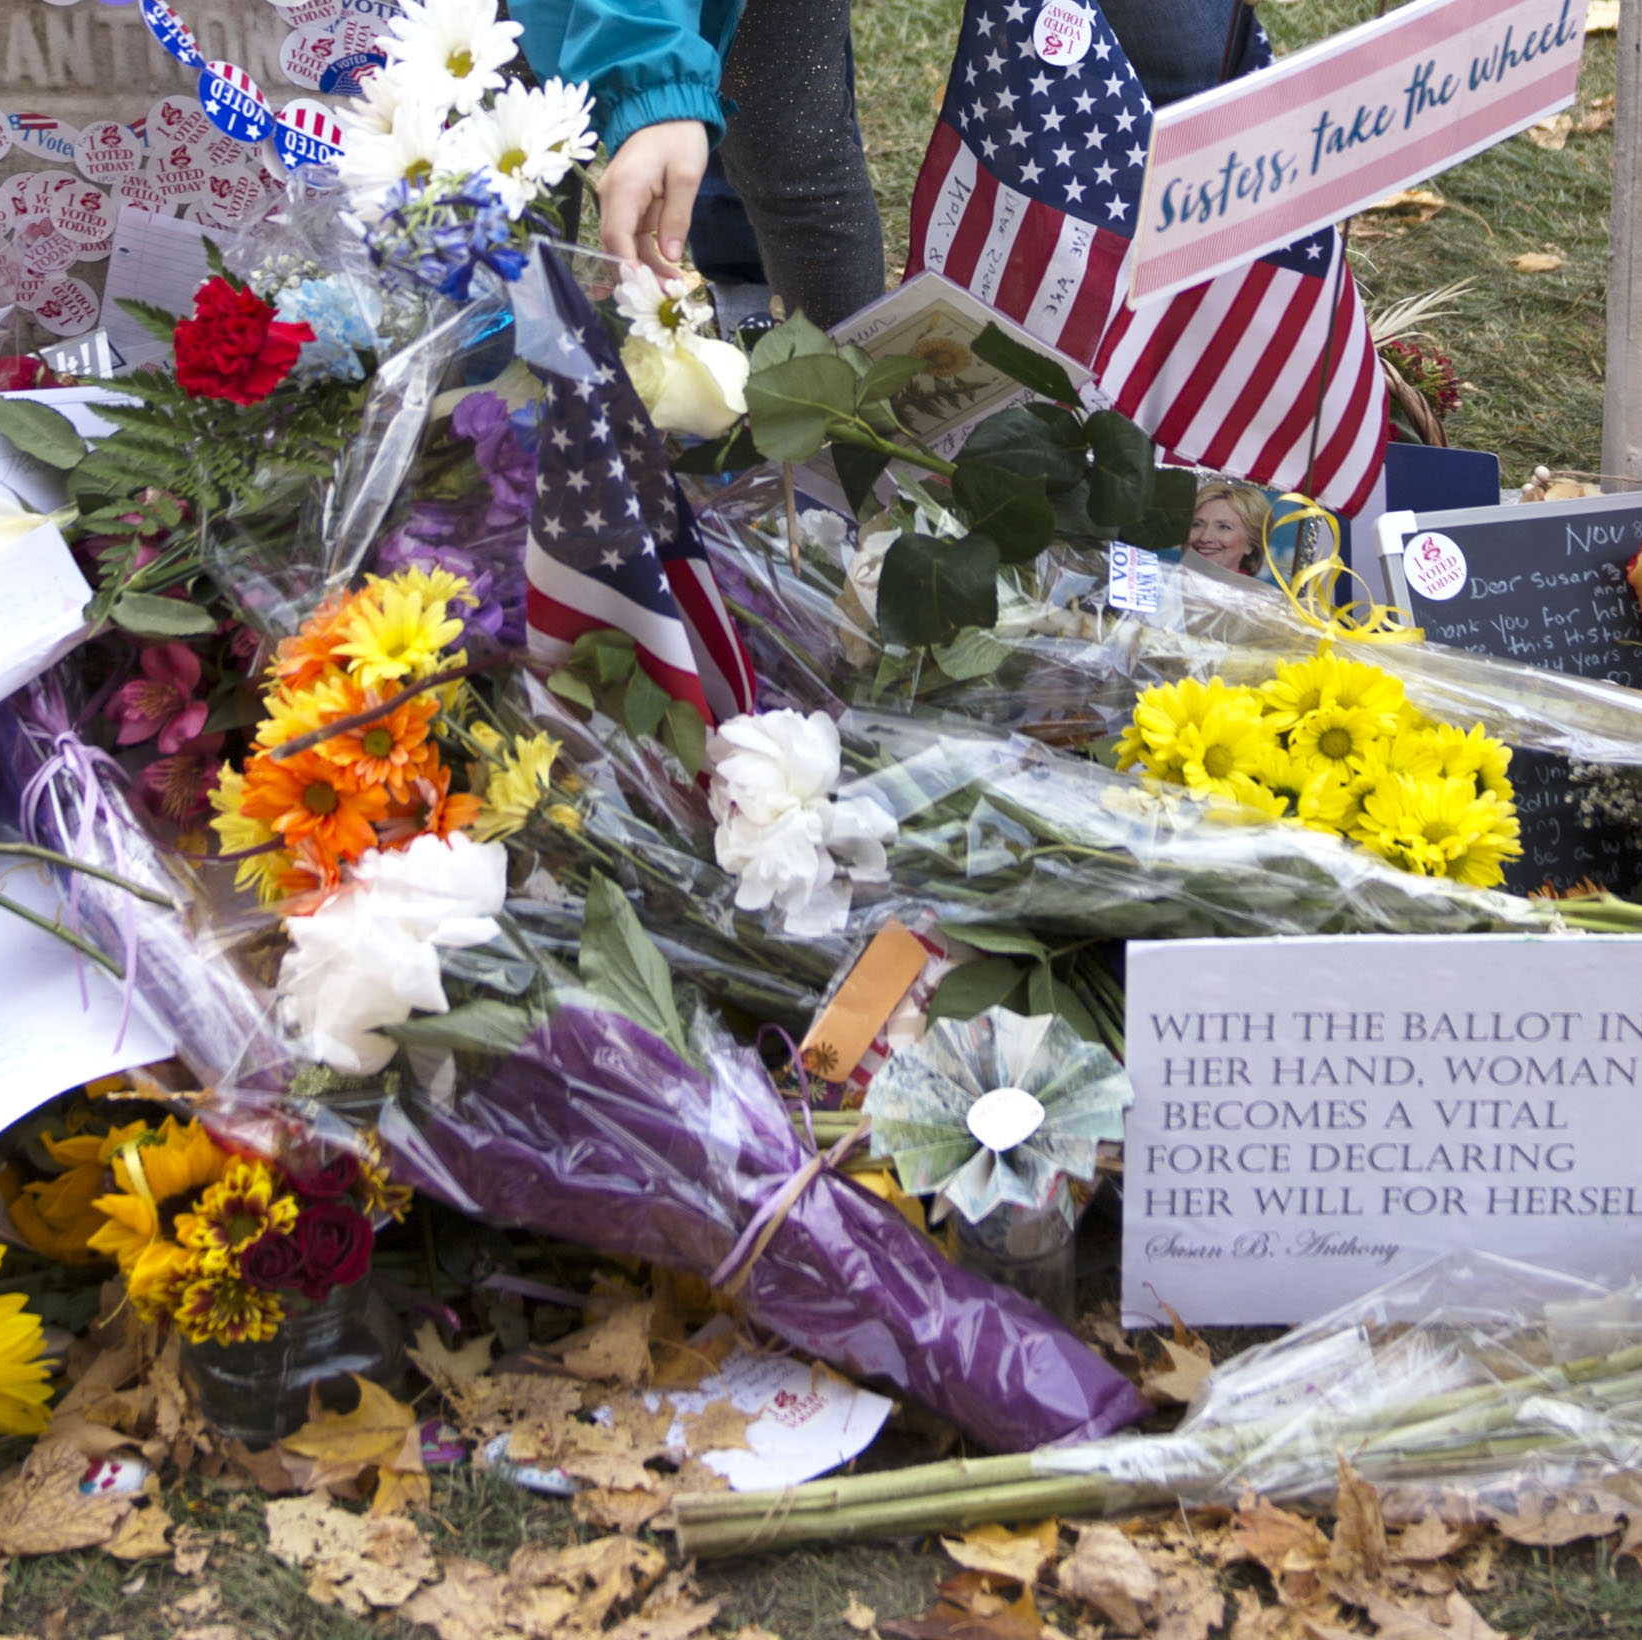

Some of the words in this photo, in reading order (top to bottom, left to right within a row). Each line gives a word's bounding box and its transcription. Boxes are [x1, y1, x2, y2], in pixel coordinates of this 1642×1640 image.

[1043, 16, 1083, 42] VOTED
[1047, 3, 1087, 29] TODAY!
[1066, 39, 1076, 55] I
[210, 77, 268, 128] VOTED
[22, 125, 33, 142] I
[1156, 148, 1300, 235] Sisters,
[1310, 109, 1398, 177] take
[1402, 57, 1461, 131] the
[1413, 555, 1424, 570] I
[1417, 554, 1459, 584] VOTED
[1424, 567, 1466, 598] TODAY!
[1469, 573, 1524, 601] Dear
[1529, 567, 1601, 592] Susan
[1489, 612, 1530, 646] you
[1541, 604, 1581, 630] for
[1150, 1012, 1276, 1043] WITH
[1292, 1011, 1386, 1042] THE
[1402, 1011, 1582, 1043] BALLOT
[1162, 1057, 1253, 1088] HER
[1444, 1055, 1639, 1088] WOMAN
[1162, 1100, 1367, 1131] BECOMES
[1384, 1100, 1415, 1131] A
[1433, 1099, 1570, 1131] VITAL
[1146, 1143, 1292, 1174] FORCE
[1308, 1142, 1577, 1174] DECLARING
[1144, 1186, 1233, 1218] HER
[1251, 1186, 1363, 1217] WILL
[1381, 1185, 1469, 1217] FOR
[1143, 1230, 1226, 1262] Susan
[1232, 1231, 1275, 1260] B.
[1285, 1230, 1401, 1267] Anthony
